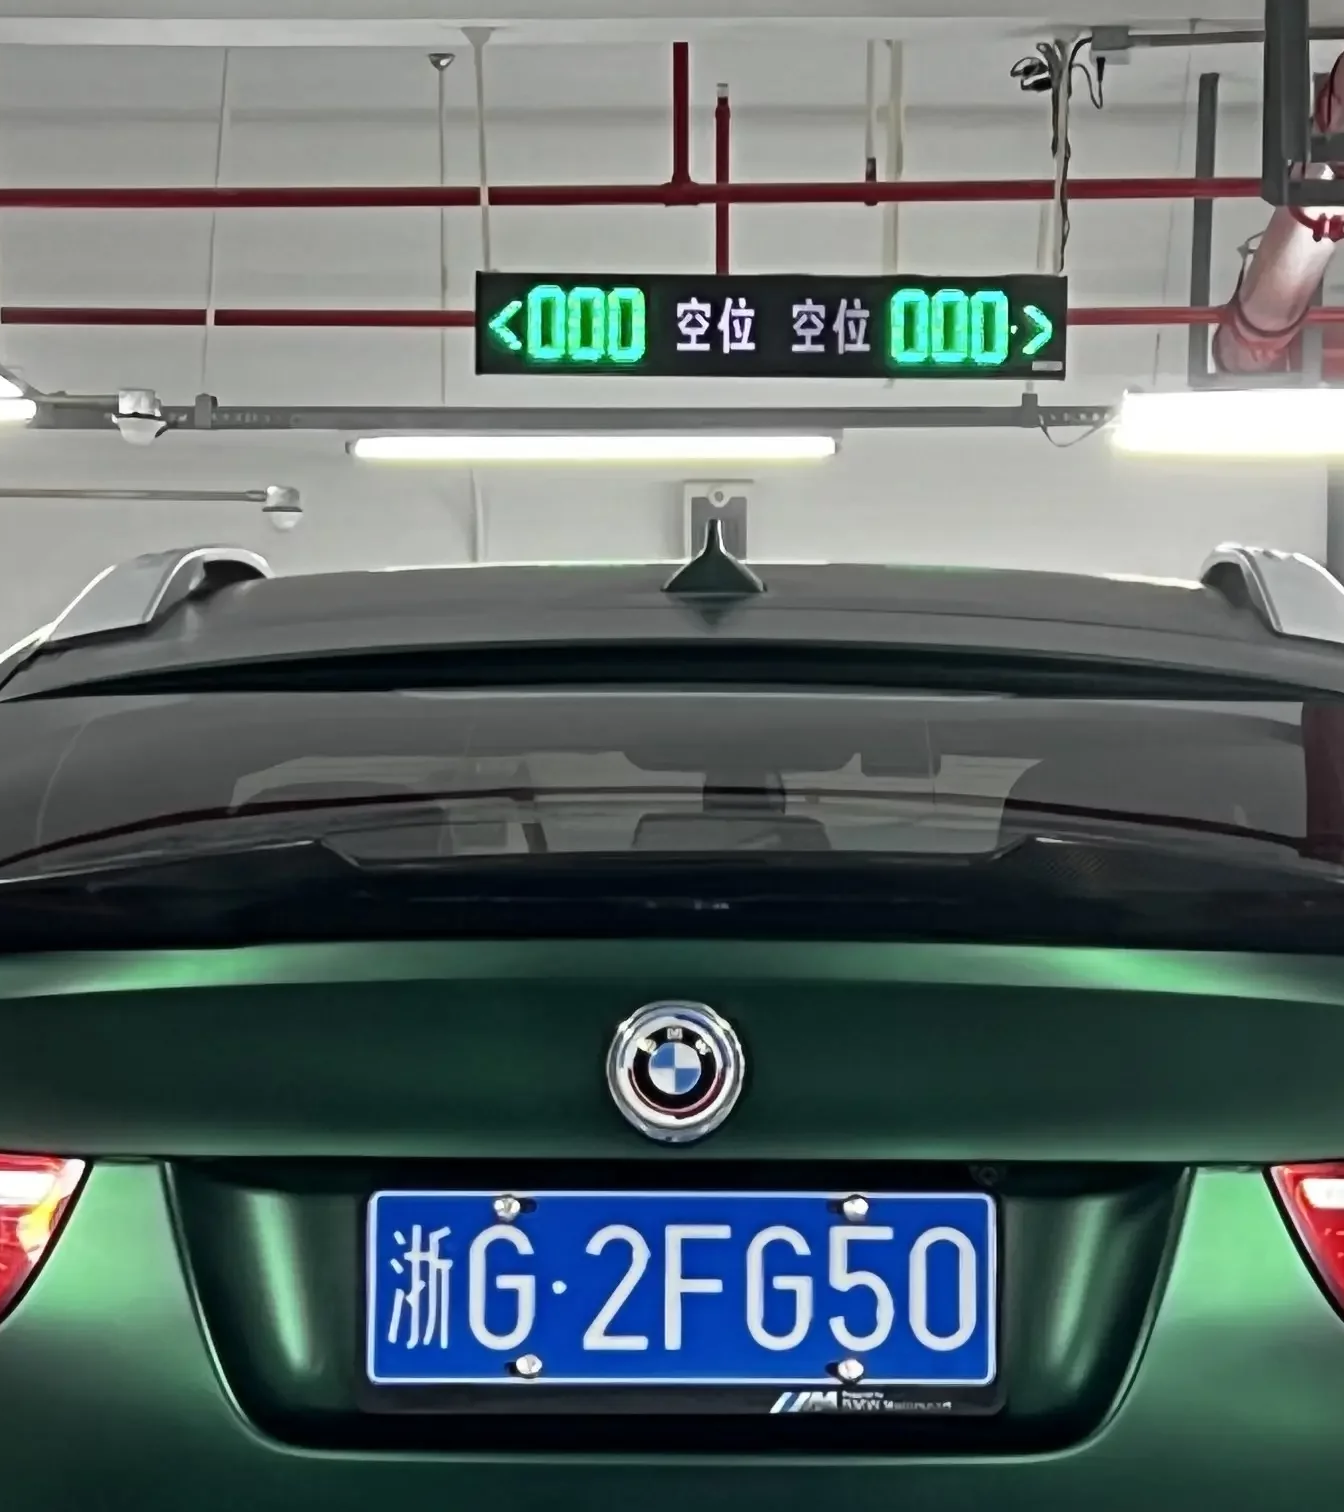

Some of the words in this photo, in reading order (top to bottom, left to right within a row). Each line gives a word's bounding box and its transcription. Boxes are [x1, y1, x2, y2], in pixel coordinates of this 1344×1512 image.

[527, 284, 645, 363] 000
[676, 297, 755, 354] 空位
[791, 298, 871, 354] 空位
[891, 288, 1009, 366] 000
[388, 1224, 977, 1352] 浙G·2FG50
